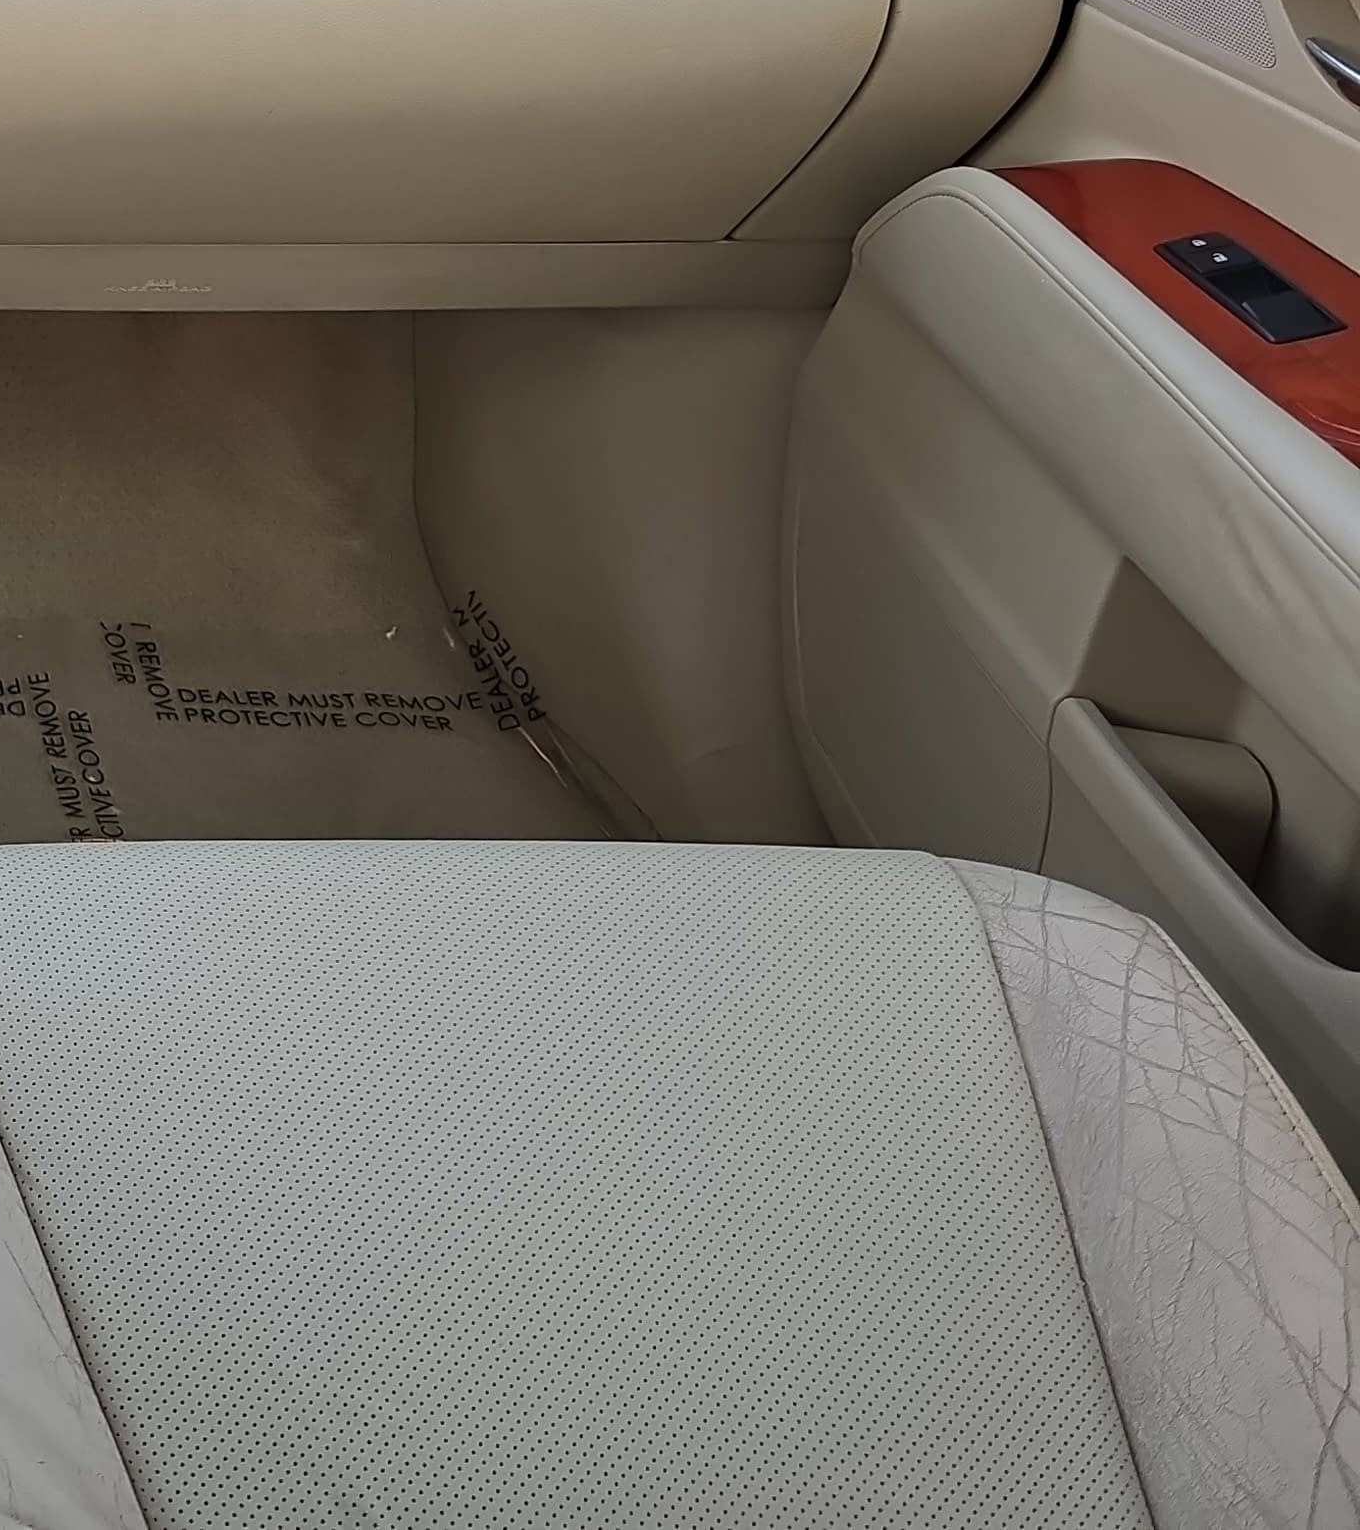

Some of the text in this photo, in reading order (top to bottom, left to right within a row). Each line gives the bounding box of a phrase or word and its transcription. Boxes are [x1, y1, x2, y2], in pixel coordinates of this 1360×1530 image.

[100, 621, 137, 684] OVER
[135, 642, 179, 721] REMOVE
[469, 638, 521, 732] DEALER
[27, 672, 68, 759] REMOVE
[177, 689, 483, 711] DEALER MUST REMOVE
[185, 708, 456, 732] PROTECTIVE COVER
[68, 710, 105, 785] COVER
[50, 764, 87, 818] MUST
